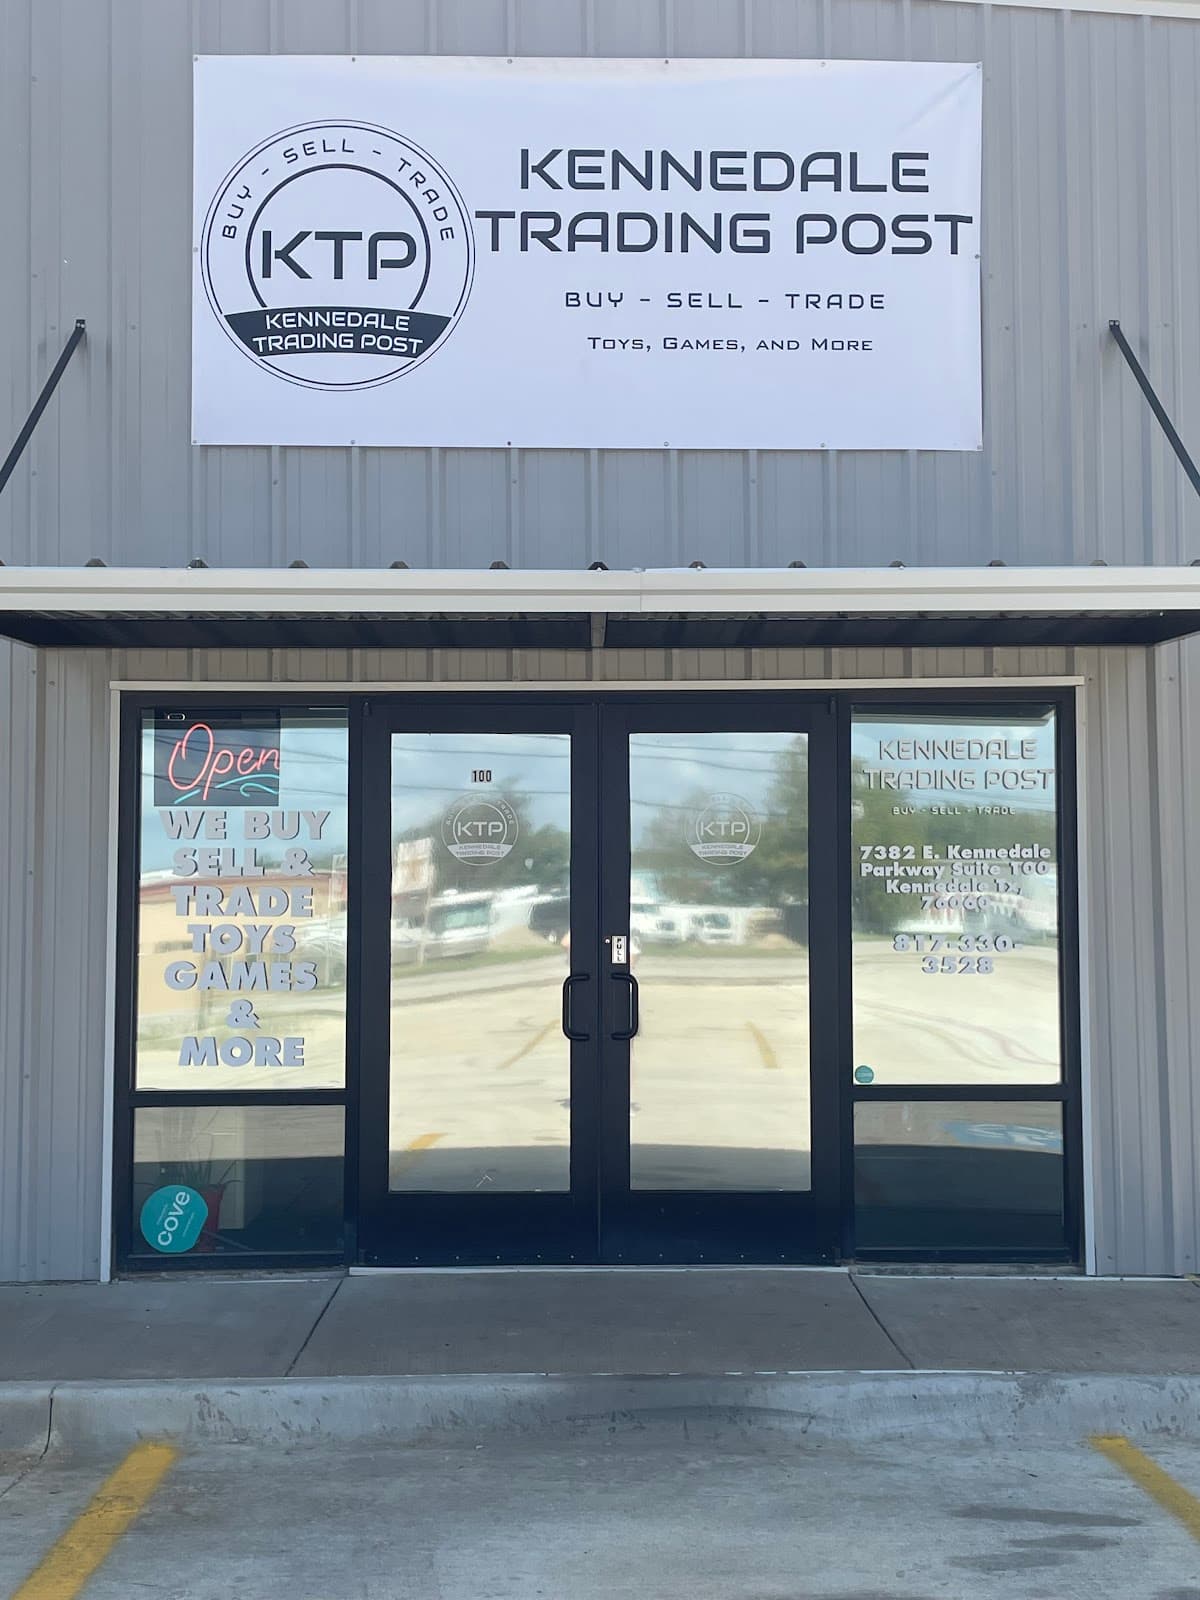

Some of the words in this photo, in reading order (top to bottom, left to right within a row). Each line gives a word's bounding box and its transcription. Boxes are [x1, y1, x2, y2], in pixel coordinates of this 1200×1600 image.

[520, 148, 930, 193] KENNEDALE
[222, 184, 253, 239] BUY
[282, 138, 355, 165] SELL
[397, 157, 455, 241] TRADE
[474, 209, 771, 254] TRADING
[795, 212, 974, 255] POST
[261, 230, 418, 281] KTP
[564, 291, 624, 308] BUY
[666, 292, 744, 309] SELL
[784, 292, 886, 309] TRADE
[264, 311, 411, 333] KENNEDALE
[252, 332, 355, 354] TRADING
[360, 333, 424, 355] POST
[878, 738, 1039, 761] KENNEDALE
[167, 722, 281, 801] Open
[472, 769, 492, 783] 100
[863, 767, 976, 790] TRADING
[984, 767, 1056, 790] POST
[891, 806, 916, 816] BUY
[930, 806, 961, 816] SELL
[976, 806, 1017, 816] TRADE
[159, 809, 228, 841] WE
[243, 809, 331, 841] BUY
[457, 821, 504, 837] KTP
[700, 820, 746, 837] KTP
[172, 846, 266, 877] SELL
[280, 846, 316, 877] &
[859, 844, 916, 860] 7382
[921, 844, 940, 860] E.
[946, 843, 1051, 860] Kennedale
[860, 862, 945, 880] Parkway
[950, 861, 1001, 877] Suite
[1008, 861, 1051, 876] 100
[886, 878, 988, 895] Kennedale
[170, 885, 314, 918] TRADE
[186, 923, 297, 955] TOYS
[892, 933, 1024, 953] 817-330-
[164, 960, 319, 992] GAMES
[921, 955, 995, 975] 3528
[225, 998, 262, 1029] &
[178, 1035, 305, 1068] MORE
[157, 1191, 191, 1246] cove
